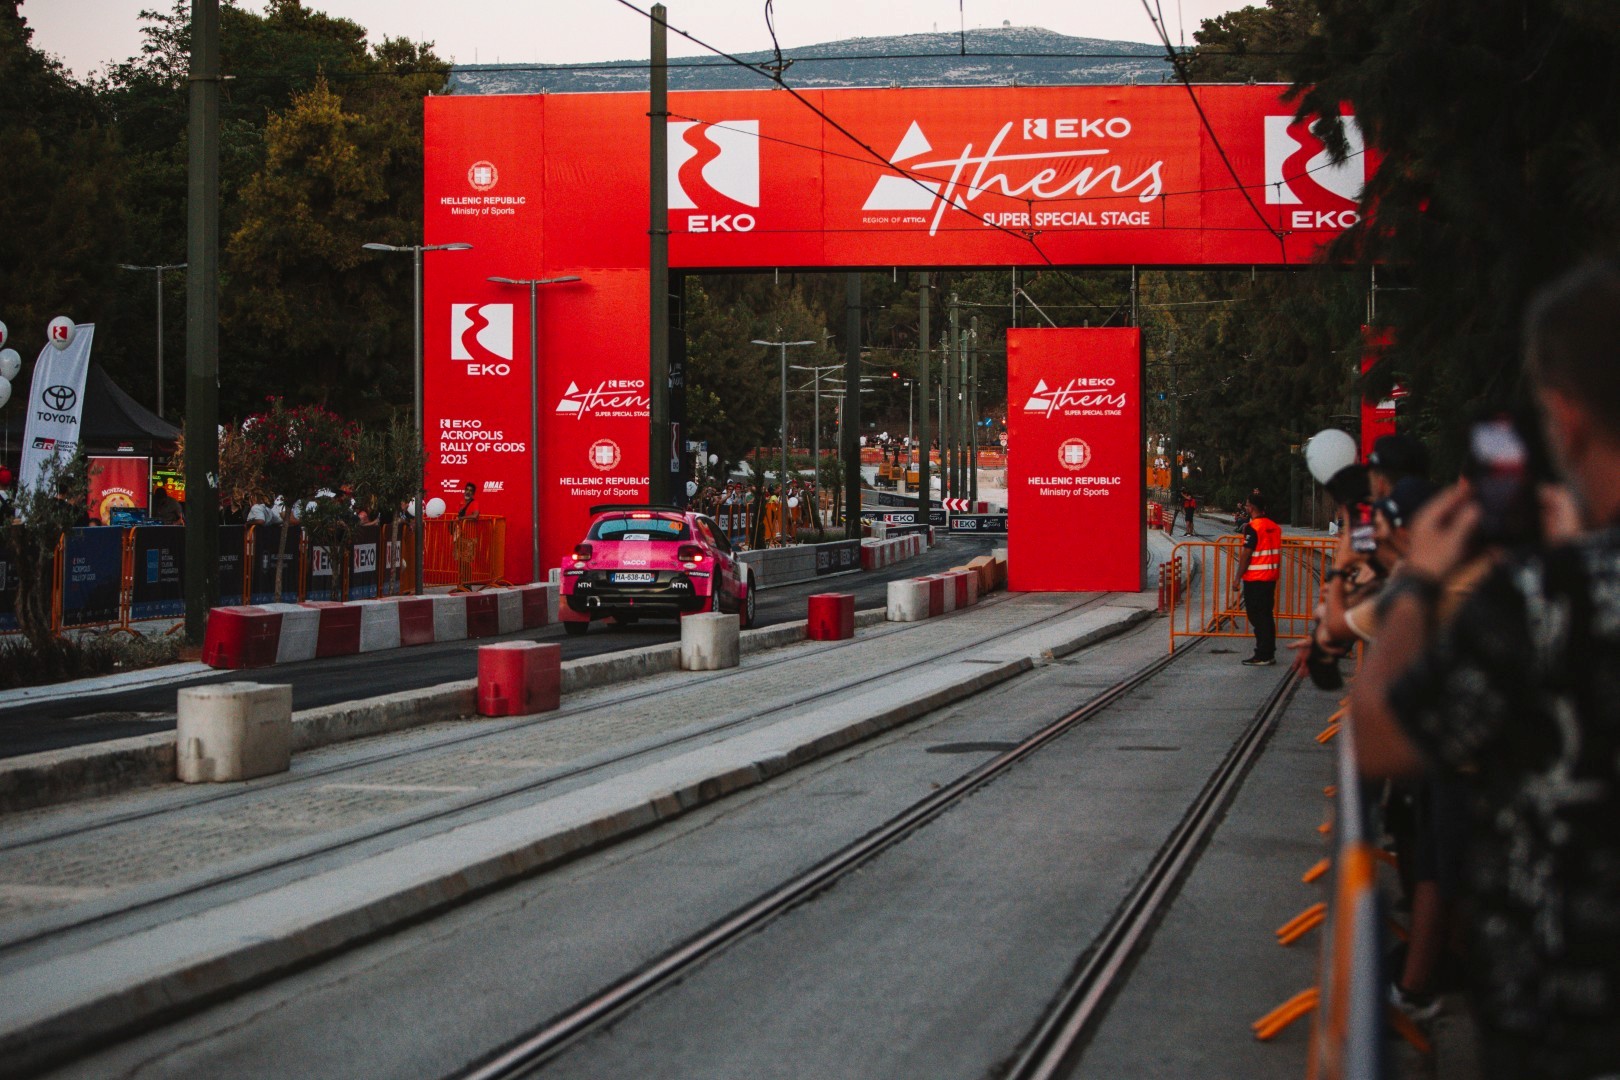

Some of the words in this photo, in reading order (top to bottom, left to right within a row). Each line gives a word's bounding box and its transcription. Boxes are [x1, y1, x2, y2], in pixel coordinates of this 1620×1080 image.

[1055, 117, 1131, 138] EKO
[441, 197, 482, 205] HELLENIC
[483, 196, 526, 204] REPUBLIC
[451, 207, 480, 216] Ministry
[491, 207, 515, 216] Sports
[688, 213, 756, 232] EKO
[983, 212, 1032, 226] SUPER
[1035, 212, 1098, 226] SPECIAL
[1100, 211, 1150, 225] STAGE
[1291, 210, 1360, 228] EKO
[467, 364, 510, 376] EKO
[1088, 378, 1115, 386] EKO
[36, 411, 77, 424] TOYOTA
[452, 419, 482, 428] EKO
[440, 430, 503, 440] ACROPOLIS
[440, 442, 473, 452] RALLY
[475, 442, 491, 452] OF
[493, 442, 526, 452] GODS
[440, 454, 468, 465] 2025
[560, 477, 603, 485] HELLENIC
[605, 477, 650, 485] REPUBLIC
[1027, 477, 1073, 485] HELLENIC
[1074, 477, 1121, 485] REPUBLIC
[571, 488, 601, 497] Ministry
[603, 488, 611, 496] of
[613, 488, 639, 497] Sports
[1040, 488, 1070, 497] Ministry
[1072, 488, 1081, 496] of
[1083, 488, 1109, 497] Sports
[893, 514, 914, 522] EKO
[669, 521, 683, 531] 40
[959, 520, 976, 528] EKO
[360, 548, 376, 567] EKO
